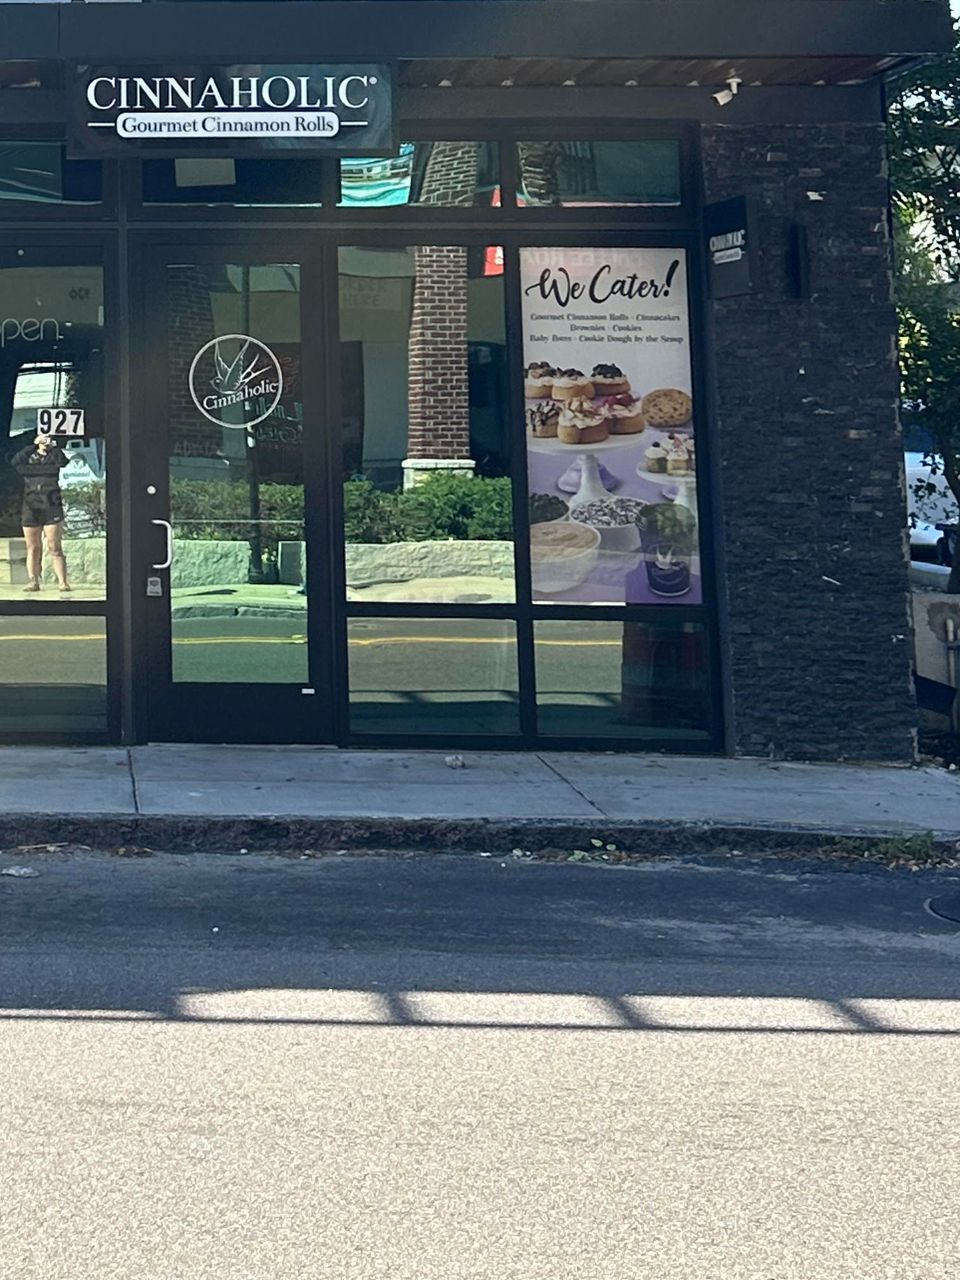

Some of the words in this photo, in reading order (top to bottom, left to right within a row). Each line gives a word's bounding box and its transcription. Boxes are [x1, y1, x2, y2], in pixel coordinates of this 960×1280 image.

[87, 75, 370, 110] CINNAHOLIC
[121, 116, 199, 133] Gourmet
[201, 115, 292, 133] Cinnamon
[294, 115, 335, 132] Rolls
[525, 268, 586, 307] We
[589, 259, 680, 304] Cater!
[202, 379, 279, 410] Cinnaholic
[39, 410, 83, 434] 927
